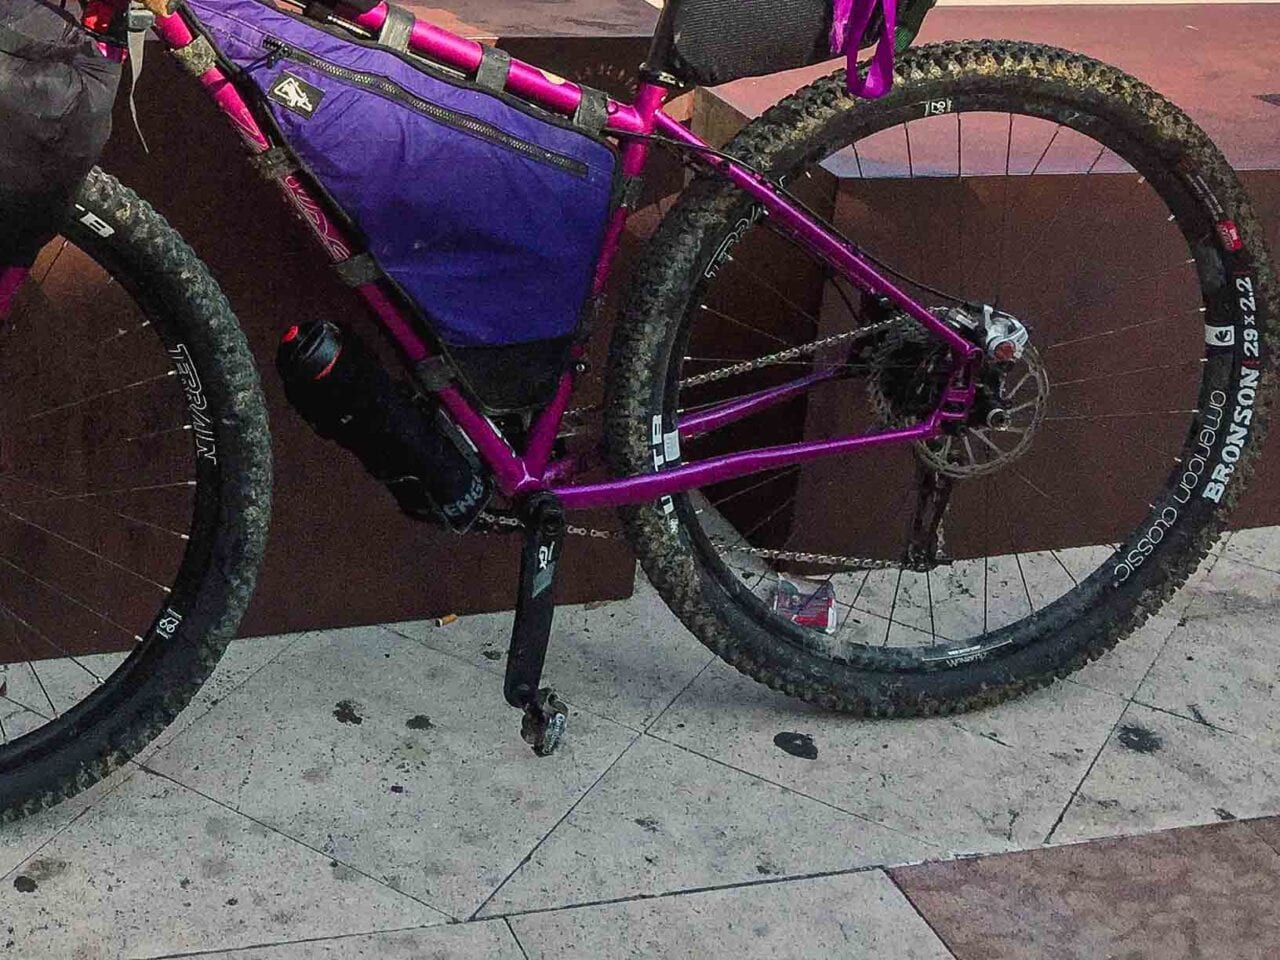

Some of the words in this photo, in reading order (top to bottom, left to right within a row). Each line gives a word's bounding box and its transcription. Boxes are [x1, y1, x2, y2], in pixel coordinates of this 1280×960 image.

[1236, 276, 1256, 312] 2.2
[1243, 314, 1256, 326] x
[1243, 328, 1260, 358] 29
[1173, 390, 1227, 504] american
[1202, 366, 1260, 504] BRONSON
